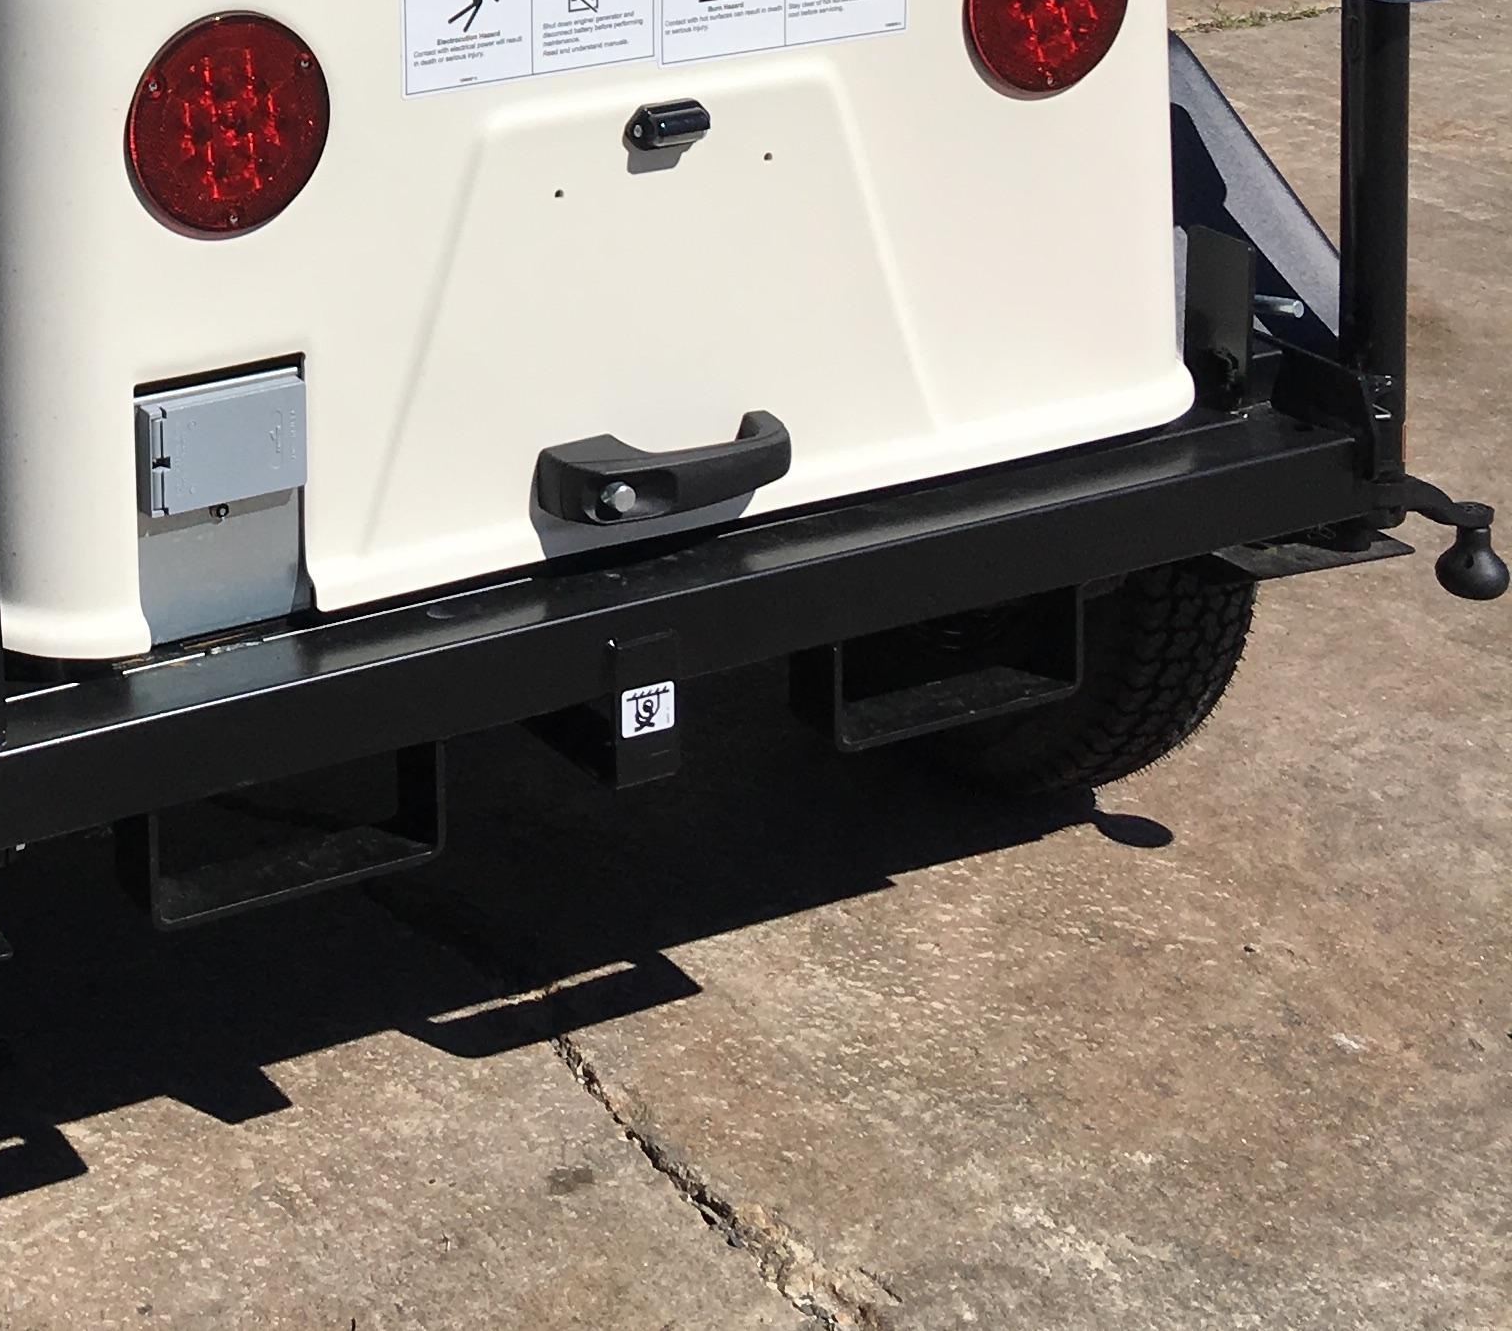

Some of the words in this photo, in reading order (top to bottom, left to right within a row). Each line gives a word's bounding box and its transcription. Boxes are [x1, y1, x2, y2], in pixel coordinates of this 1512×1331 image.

[723, 1, 745, 10] Hazard
[542, 22, 556, 30] Shut
[542, 28, 573, 39] disconnect
[573, 25, 593, 35] battery
[594, 22, 613, 31] before
[613, 18, 644, 29] performing
[664, 18, 686, 27] Contact
[436, 33, 478, 46] Electrocution
[478, 29, 501, 40] Hazard
[413, 49, 437, 58] Contact
[437, 46, 450, 54] with
[450, 42, 476, 52] electrical
[476, 40, 495, 49] power
[495, 37, 506, 45] will
[506, 35, 523, 43] result
[542, 48, 559, 57] Read
[559, 46, 571, 54] and
[571, 42, 603, 53] understand
[420, 56, 437, 66] death
[445, 53, 467, 62] serious
